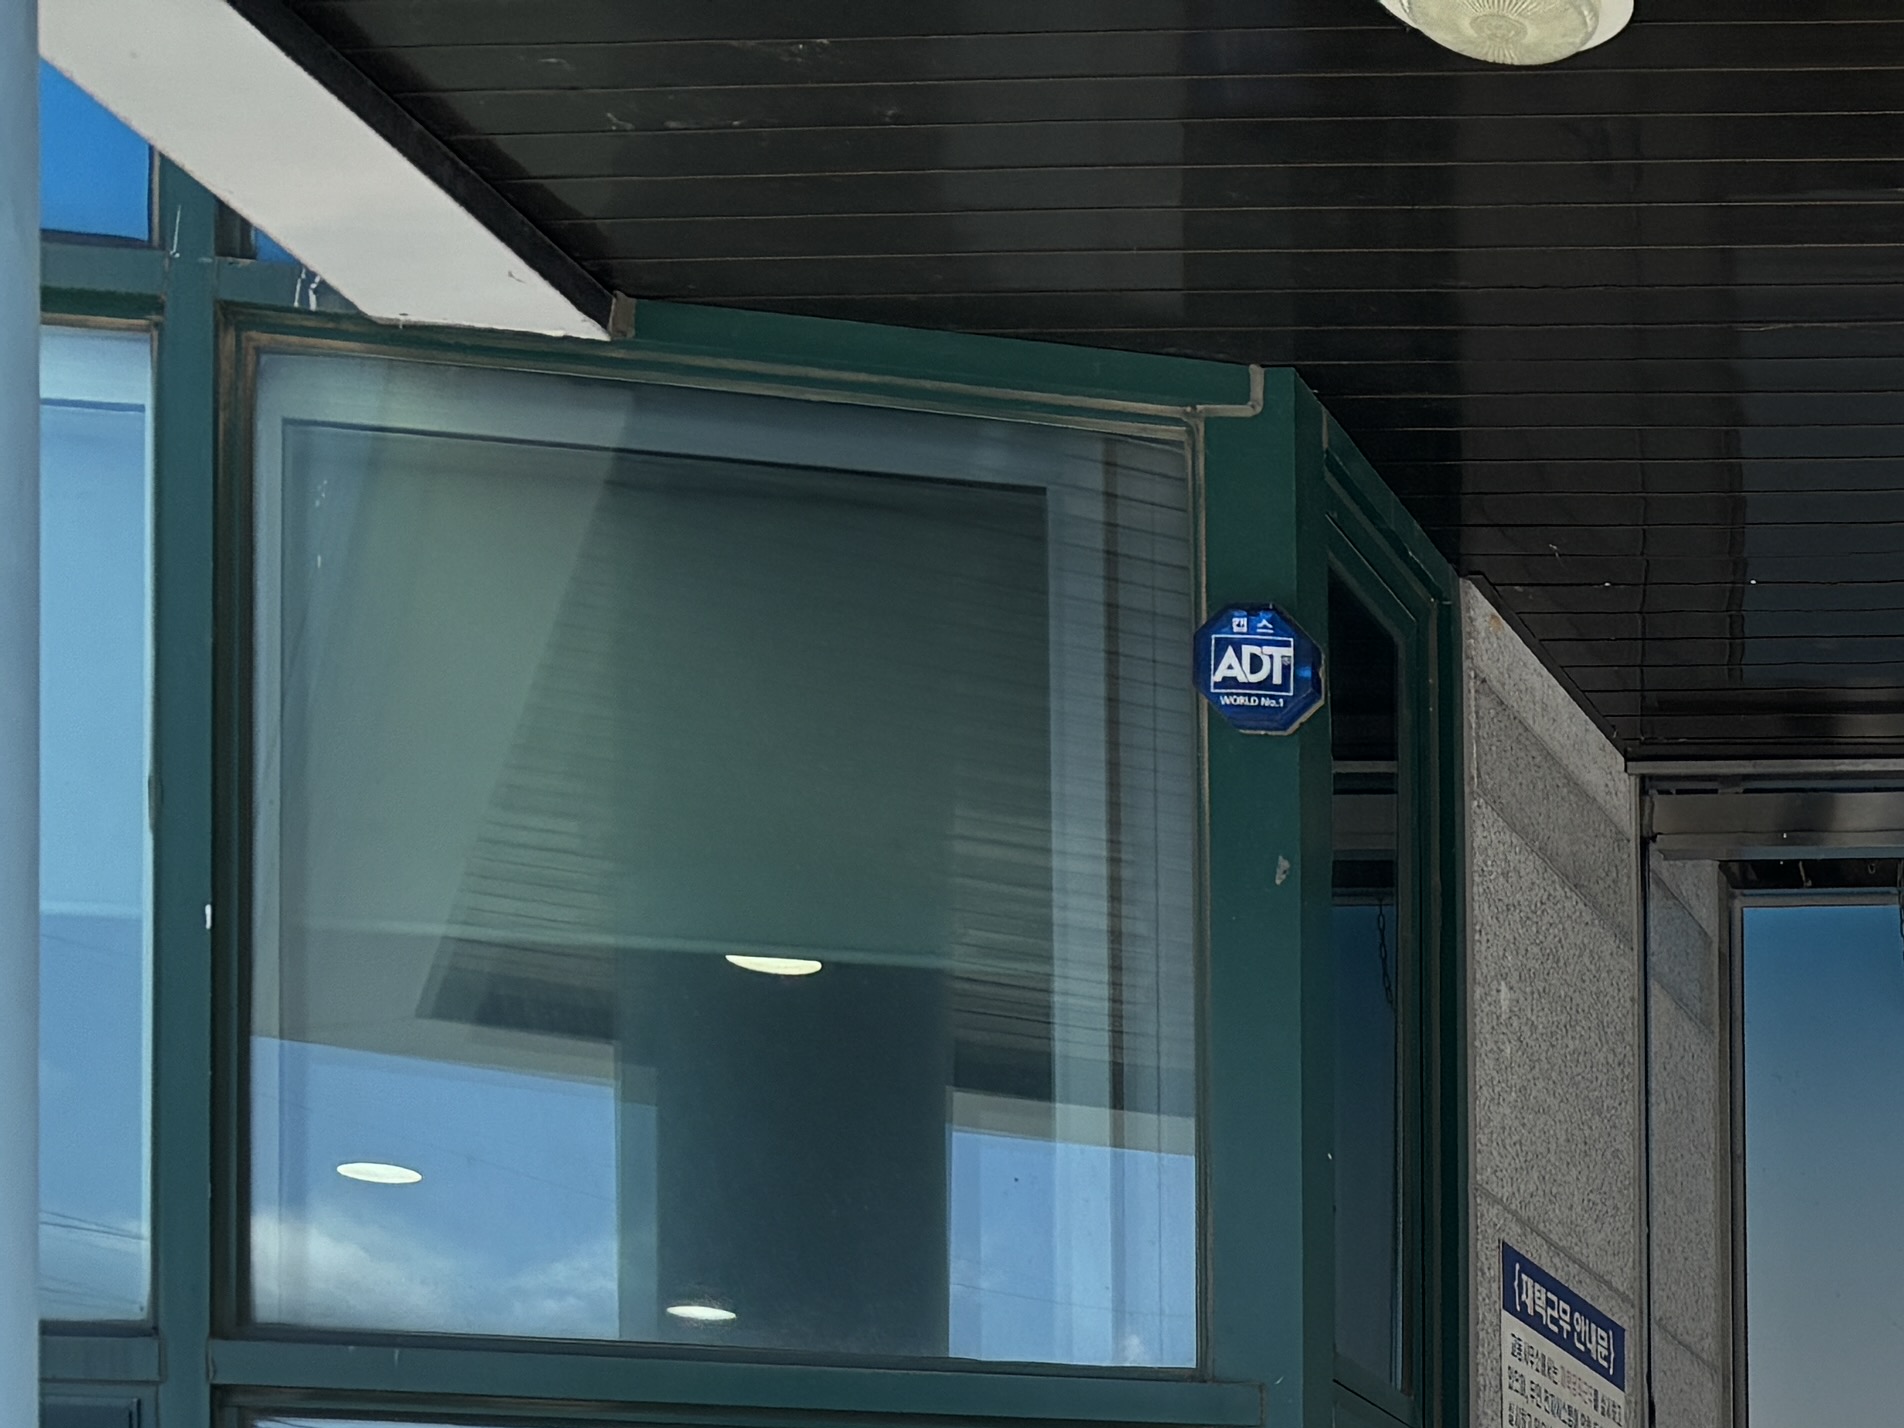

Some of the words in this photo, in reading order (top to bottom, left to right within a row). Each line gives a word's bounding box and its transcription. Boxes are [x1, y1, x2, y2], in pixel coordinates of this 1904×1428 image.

[1213, 645, 1292, 685] ADT
[1220, 696, 1258, 706] WORLD
[1261, 697, 1284, 707] No.1
